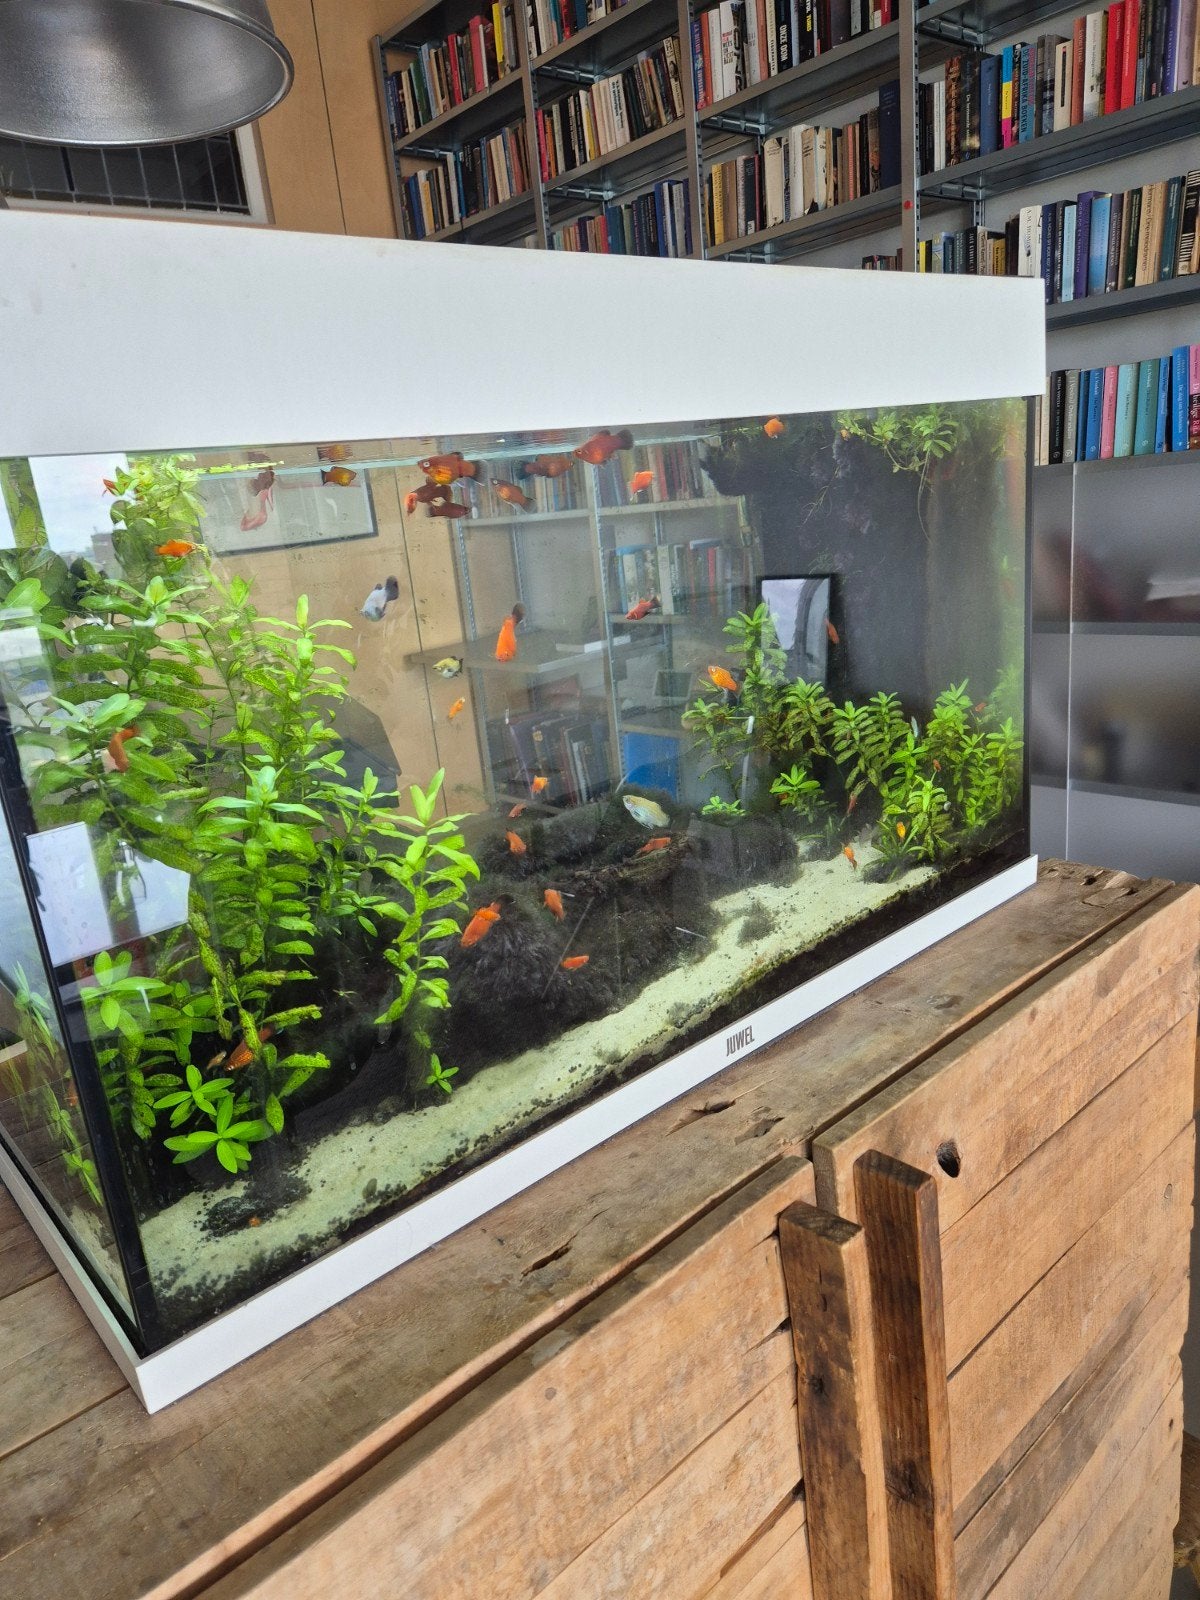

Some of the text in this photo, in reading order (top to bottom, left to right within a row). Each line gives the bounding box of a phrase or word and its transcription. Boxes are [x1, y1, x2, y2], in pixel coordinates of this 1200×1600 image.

[779, 24, 788, 45] ONZE
[1021, 60, 1029, 104] ZUID-AFRIKA
[1020, 104, 1028, 133] BOEKEN
[1192, 382, 1200, 393] De
[1190, 394, 1200, 419] heilige
[1192, 420, 1200, 435] Rita
[726, 1025, 755, 1057] JUWEL
